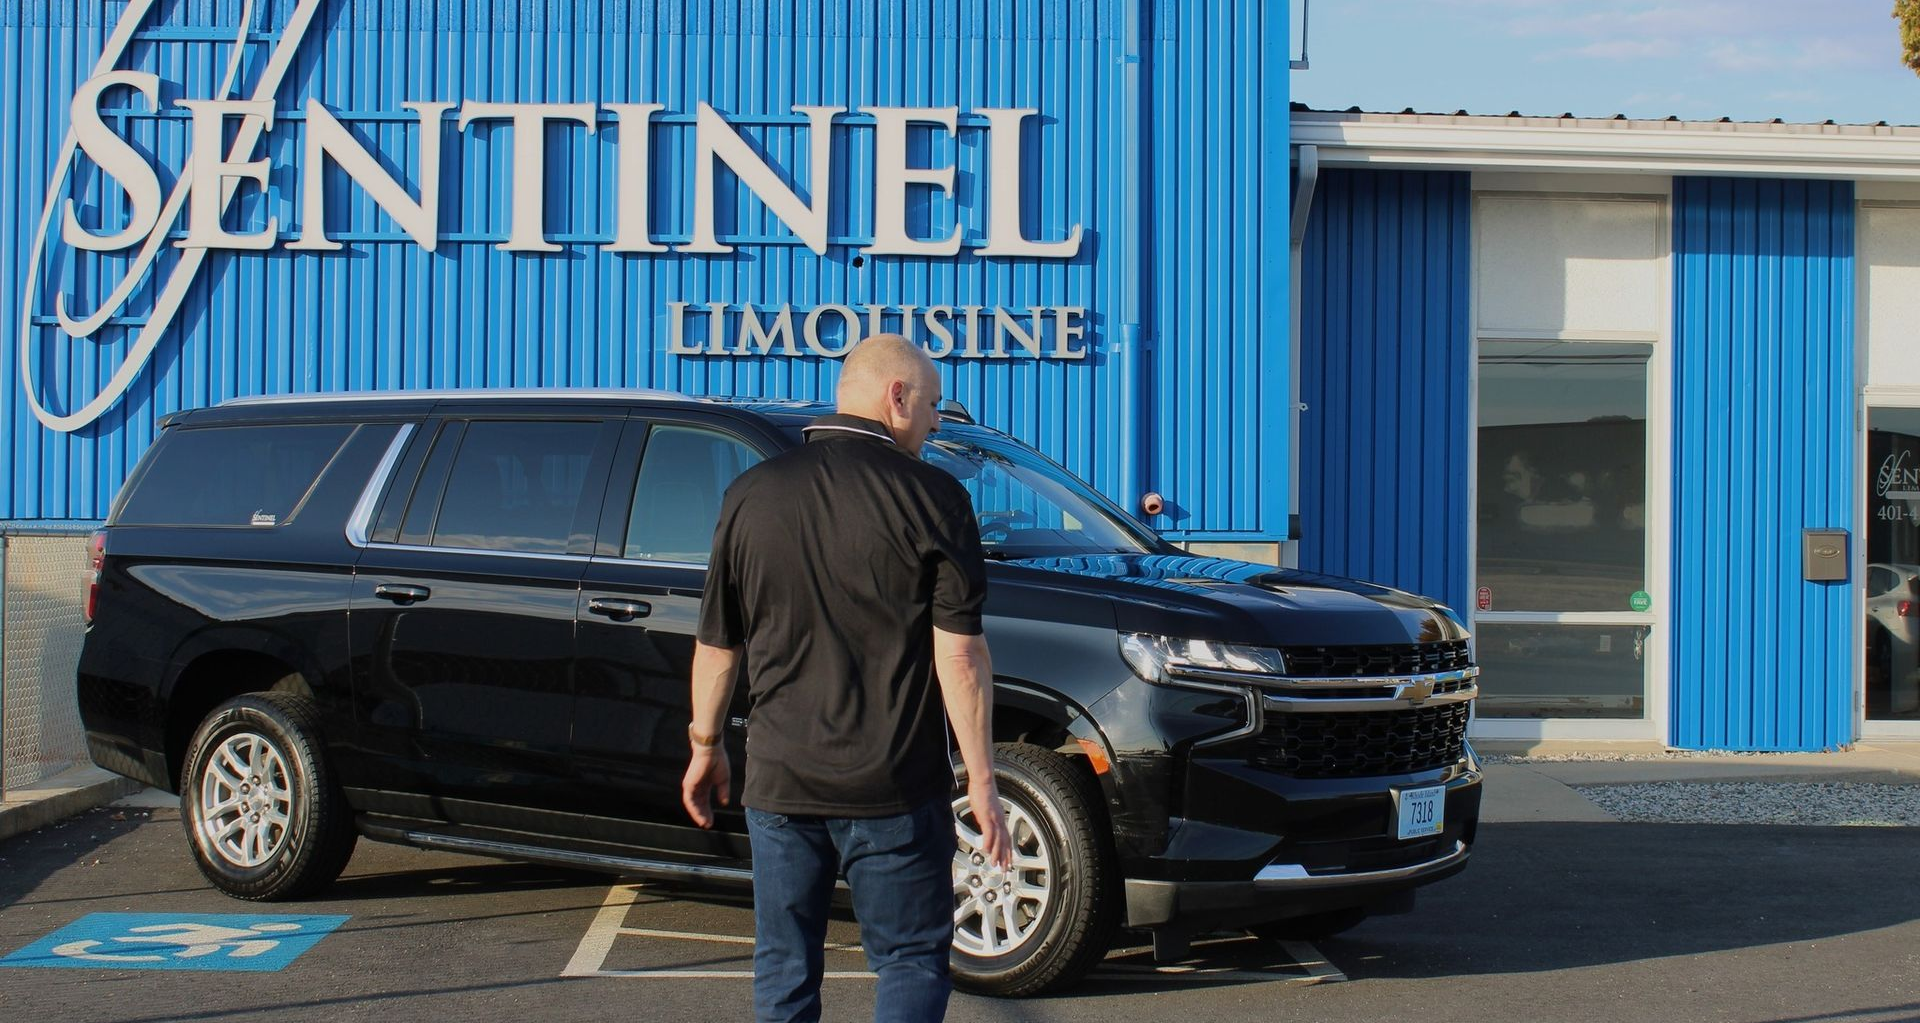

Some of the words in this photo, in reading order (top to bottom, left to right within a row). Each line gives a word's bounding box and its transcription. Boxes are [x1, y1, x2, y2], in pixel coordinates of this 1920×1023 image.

[63, 69, 1083, 258] SENTINEL
[667, 301, 1088, 360] LIMOUSINE
[1879, 465, 1920, 485] SEN
[1877, 505, 1920, 521] 401-4
[1411, 800, 1433, 825] 7318
